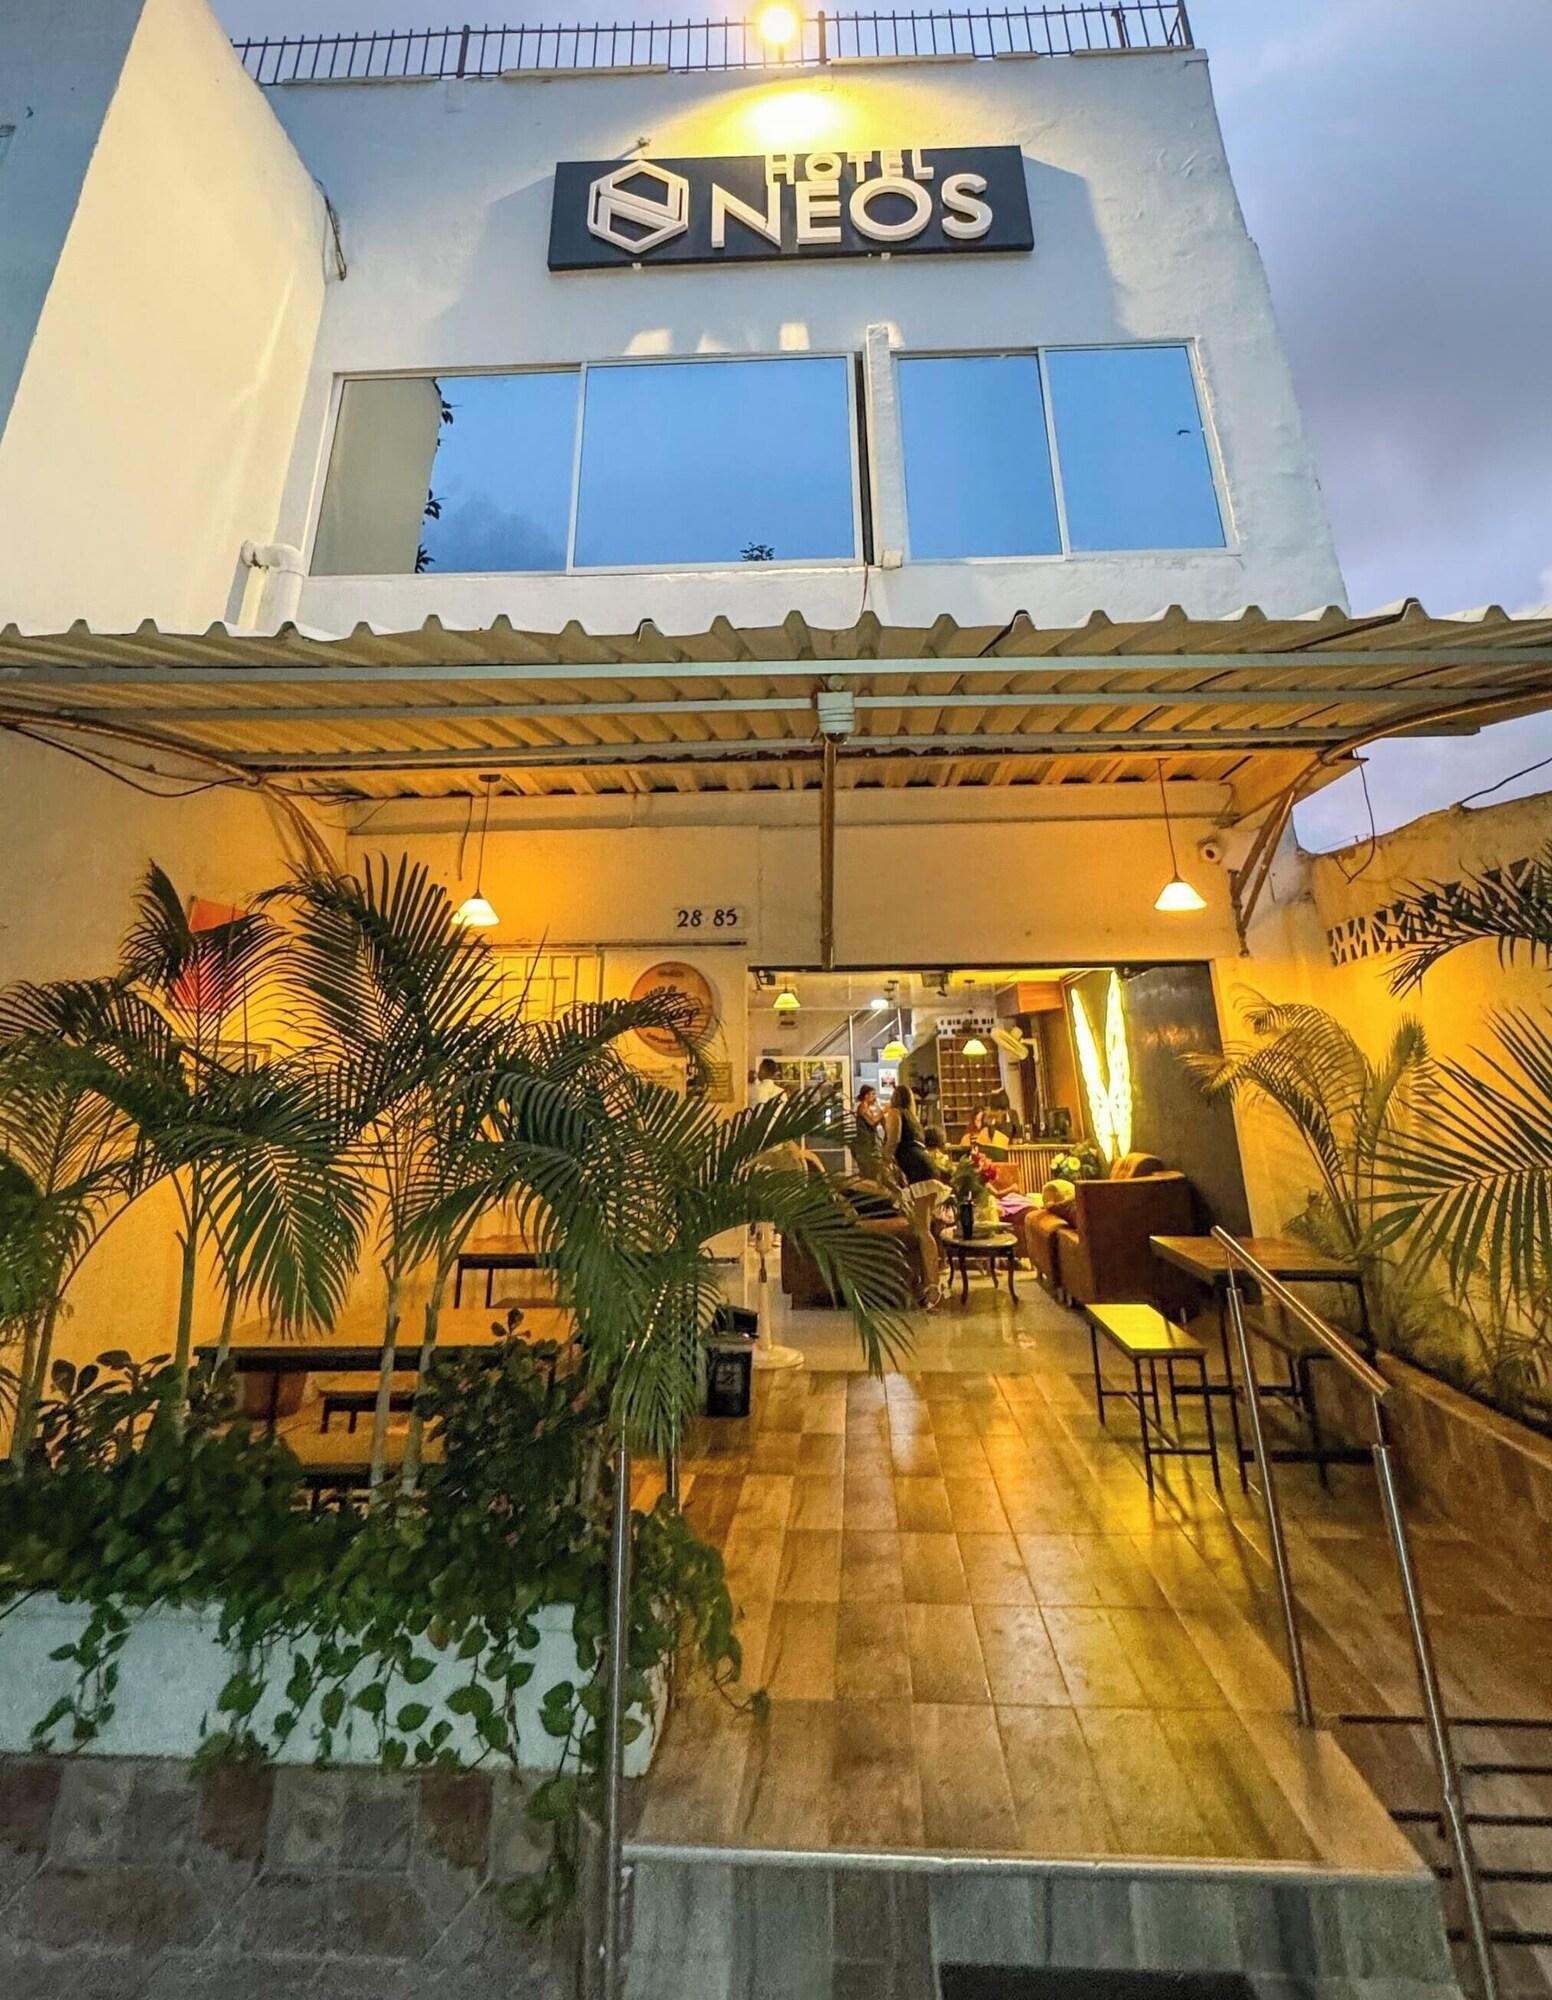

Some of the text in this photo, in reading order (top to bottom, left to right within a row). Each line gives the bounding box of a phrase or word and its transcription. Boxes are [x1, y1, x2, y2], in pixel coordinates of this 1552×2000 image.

[764, 149, 934, 185] HOTEL
[711, 173, 993, 248] NEOS
[677, 907, 738, 928] 28 85
